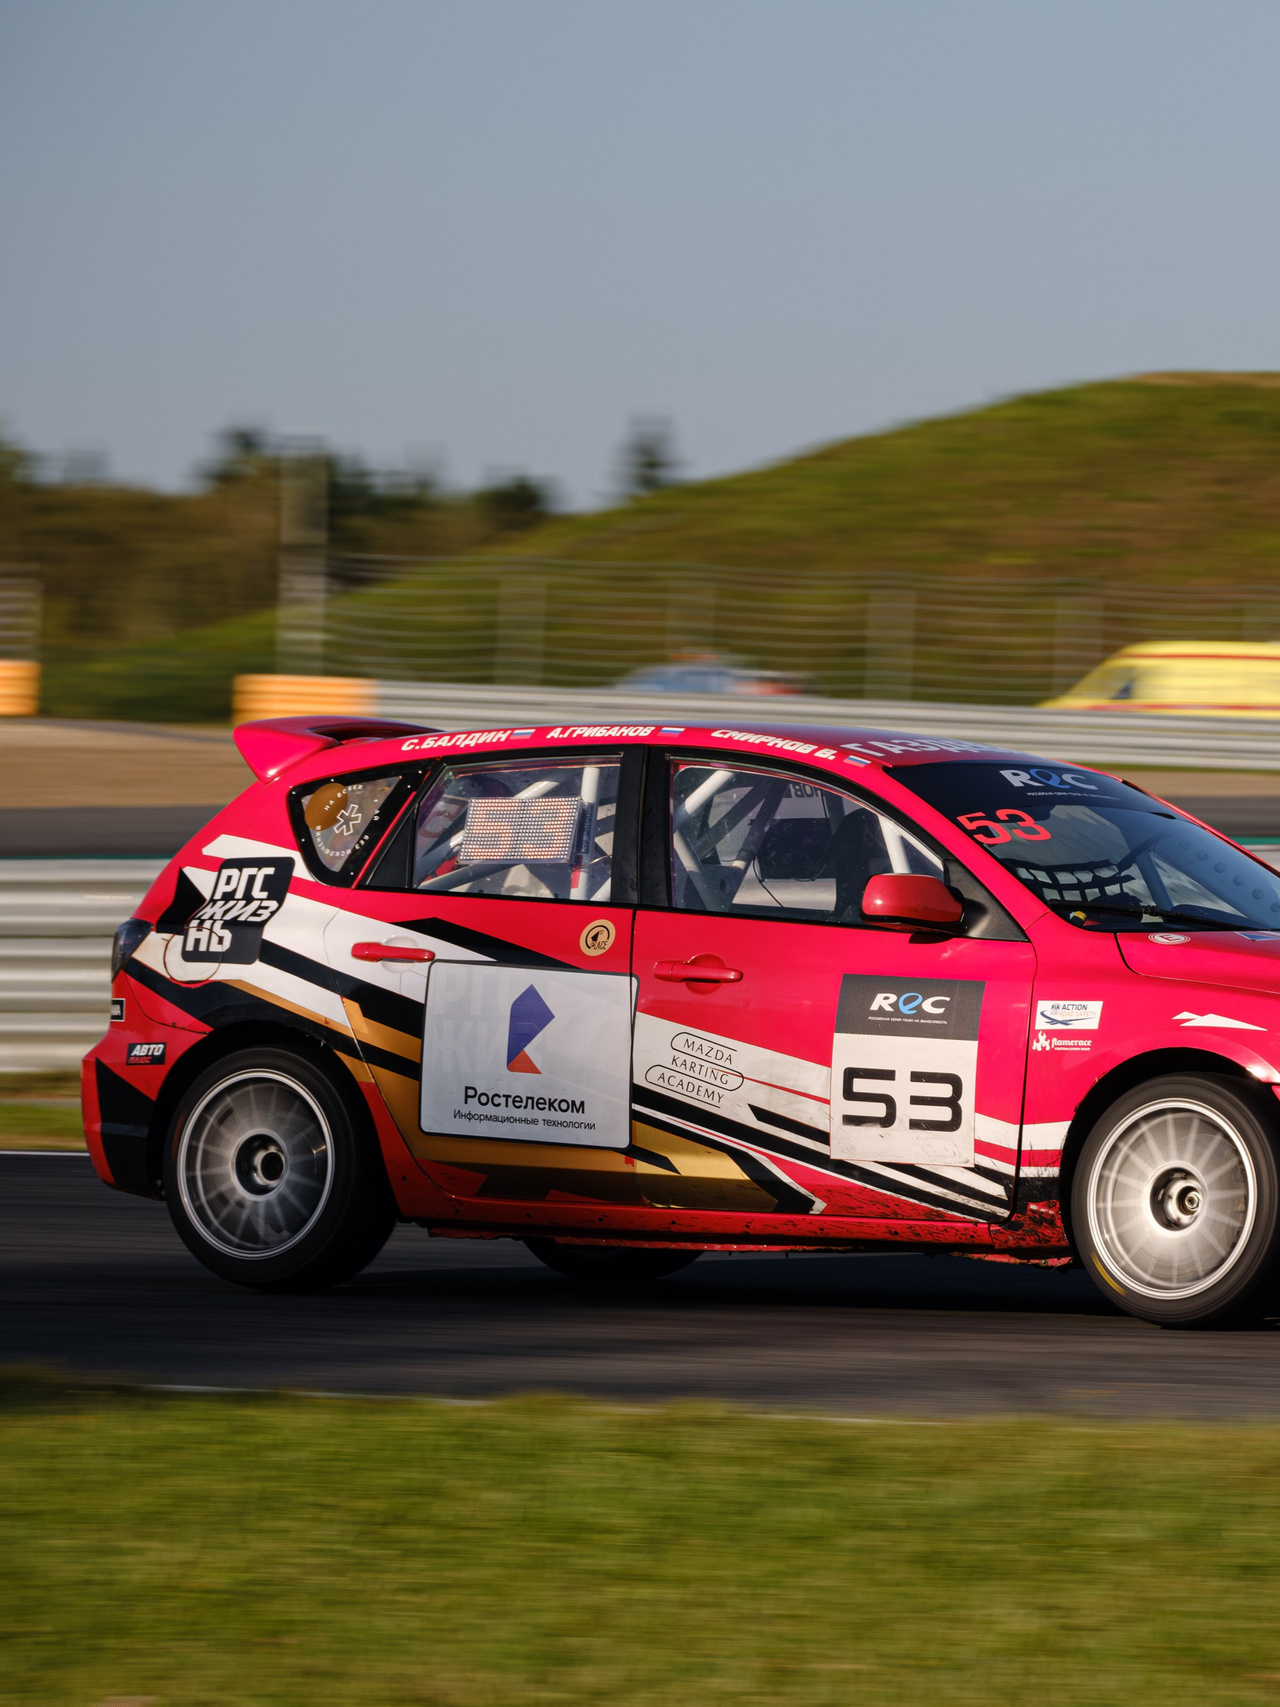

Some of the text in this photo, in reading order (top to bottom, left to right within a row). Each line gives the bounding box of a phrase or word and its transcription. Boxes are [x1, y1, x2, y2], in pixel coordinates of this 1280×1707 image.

[401, 729, 512, 751] С.БАЛДИН
[546, 726, 655, 739] А.ГРИБАНОВ
[711, 729, 838, 761] СМИРНОВ В.
[466, 798, 571, 860] 53
[956, 808, 1052, 845] 53
[213, 867, 276, 900] РГС
[195, 900, 280, 922] ЖИЗ
[185, 919, 233, 953] НЬ
[1061, 1003, 1088, 1011] ACTION
[131, 1043, 165, 1056] АВТО
[683, 1038, 733, 1065] MAZDA
[1051, 1037, 1092, 1048] flamerace
[671, 1054, 730, 1085] KARTING
[464, 1085, 586, 1114] Ростелеком
[657, 1072, 725, 1104] ACADEMY
[842, 1066, 963, 1133] 53
[453, 1109, 597, 1131] Информационные технологии
